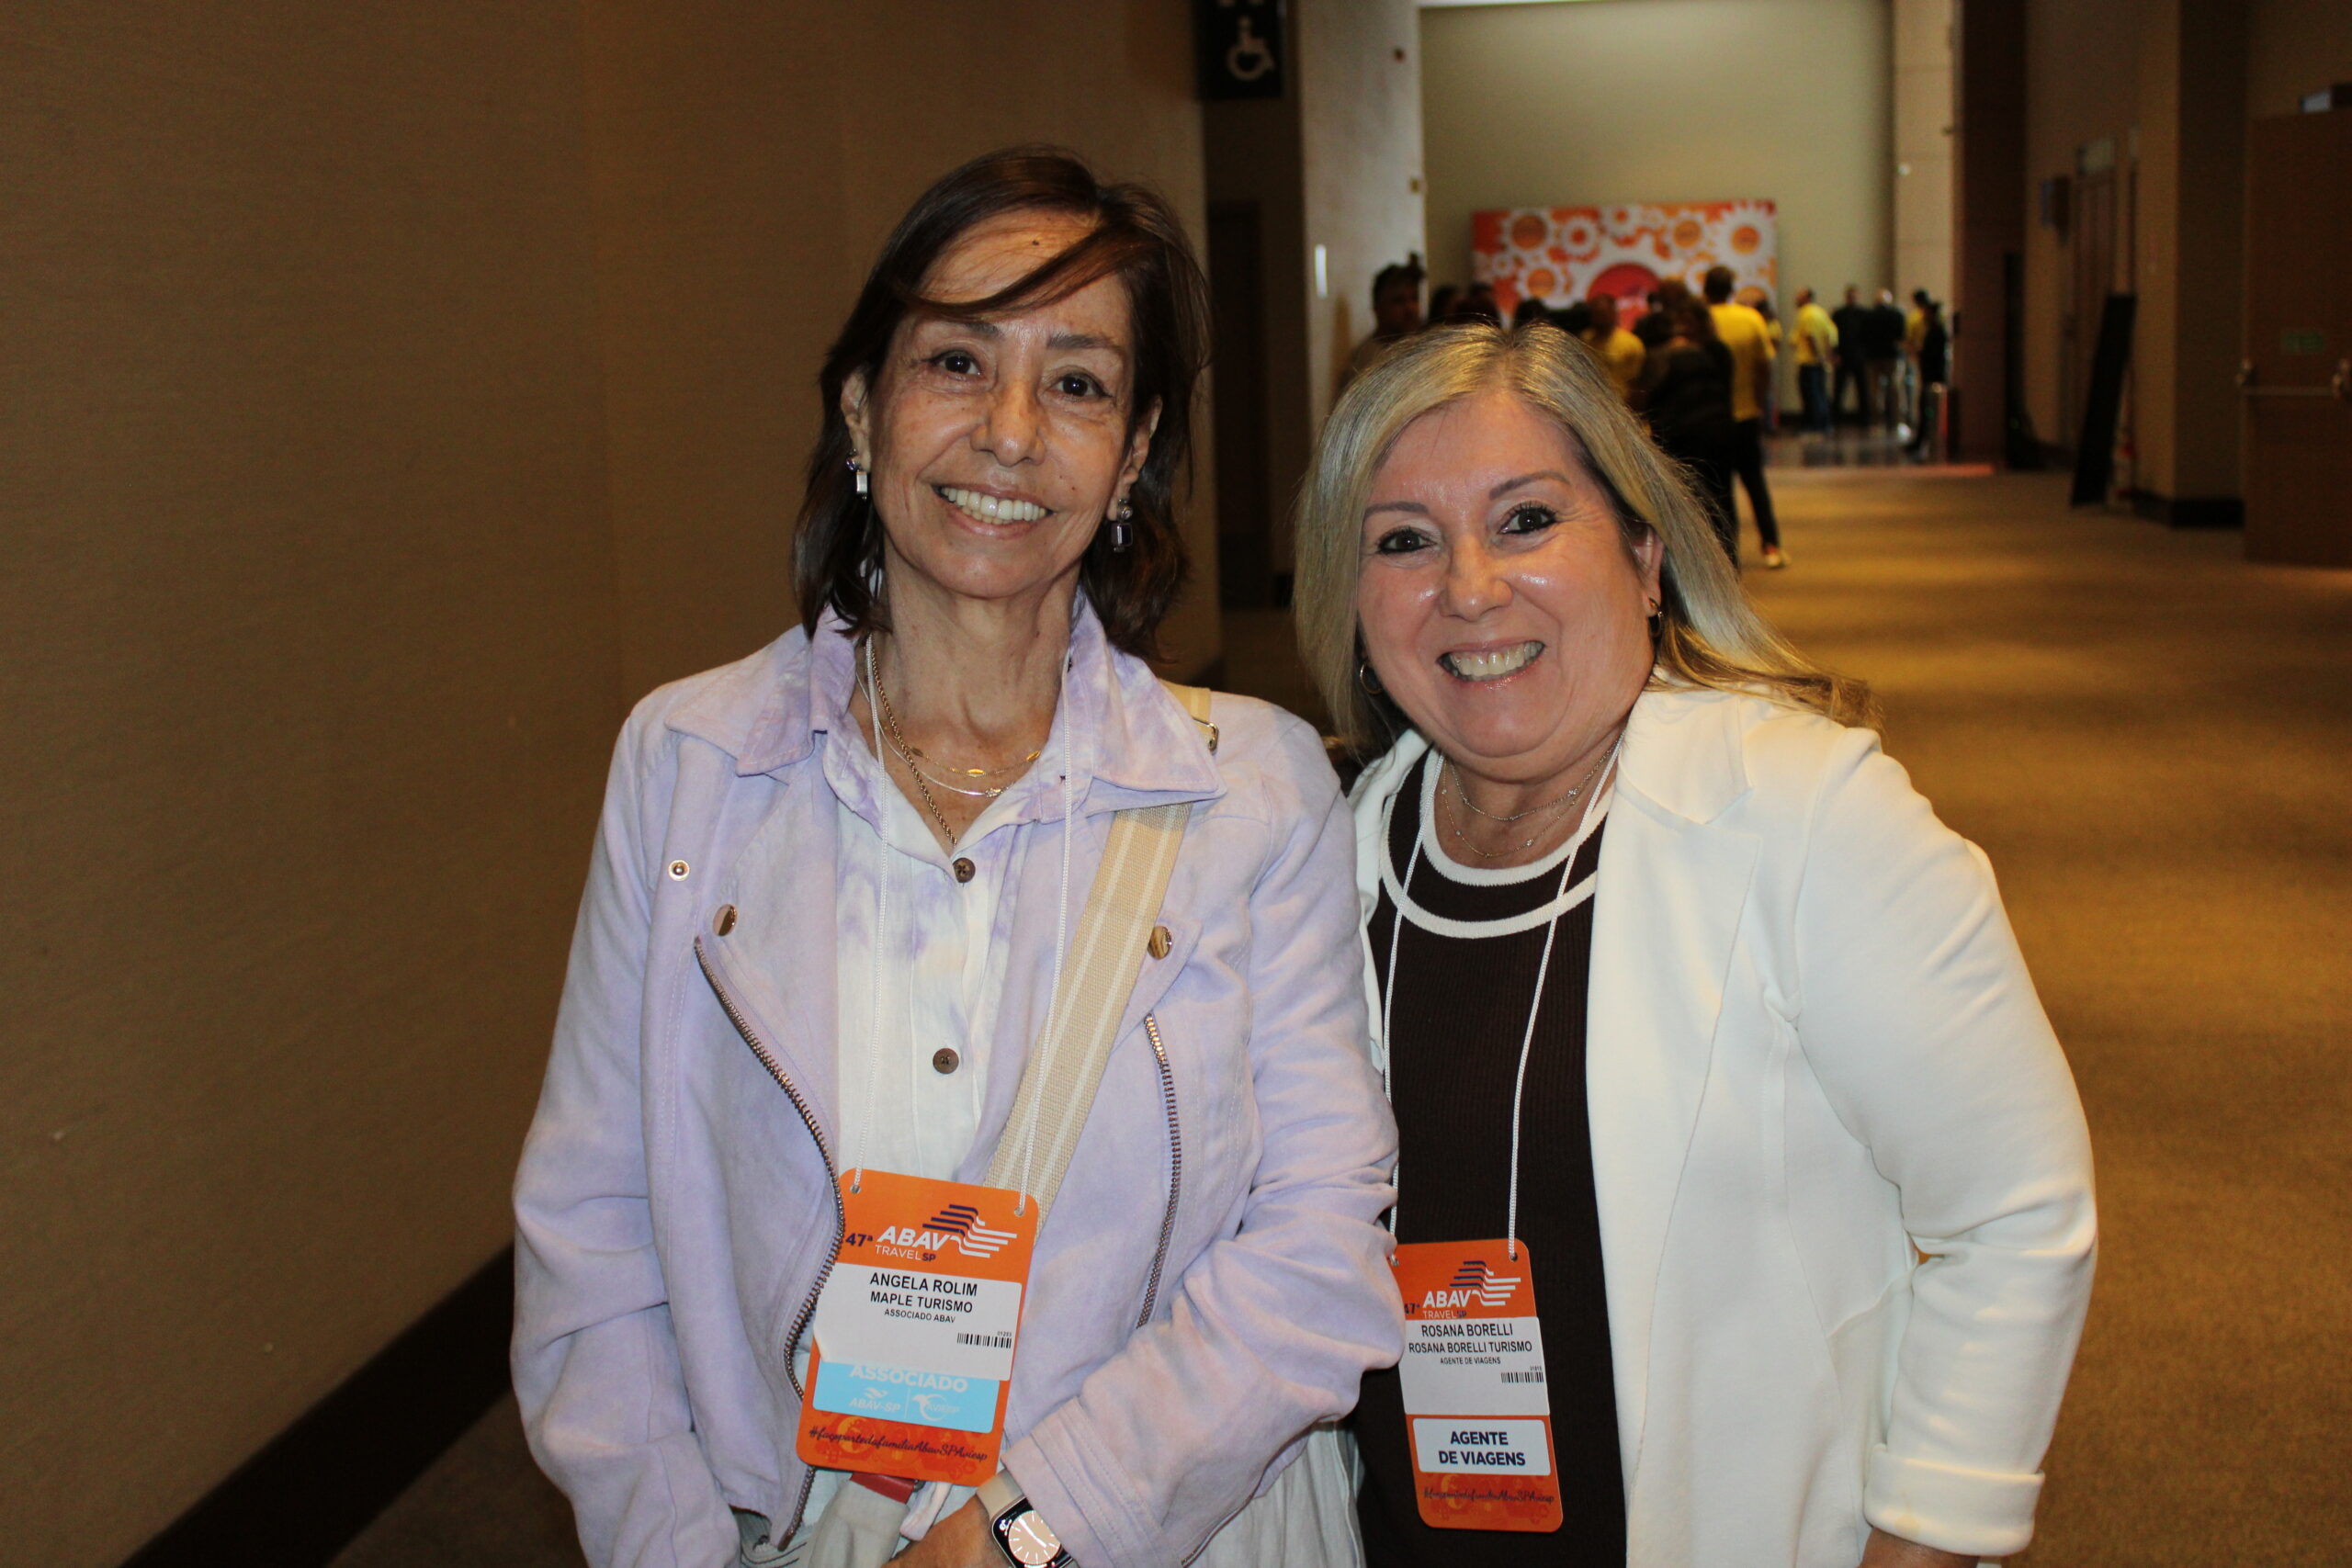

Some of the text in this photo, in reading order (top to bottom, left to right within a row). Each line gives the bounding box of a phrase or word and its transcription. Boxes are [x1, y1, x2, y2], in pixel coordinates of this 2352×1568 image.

[876, 1225, 950, 1251] ABAV
[870, 1272, 978, 1297] ANGELA ROLIM
[870, 1291, 973, 1314] MAPLE TURISMO
[1422, 1290, 1471, 1309] ABAV
[884, 1308, 956, 1324] ASSOCIADO ABAV
[1421, 1323, 1513, 1337] ROSANA BORELLI
[1408, 1340, 1532, 1353] ROSANA BORELLI TURISMO
[1440, 1357, 1464, 1365] AGENTE
[1474, 1356, 1501, 1365] VIAGENS
[848, 1365, 968, 1393] ASSOCIADO
[1451, 1431, 1509, 1446] AGENTE
[1438, 1450, 1526, 1467] DE VIAGENS
